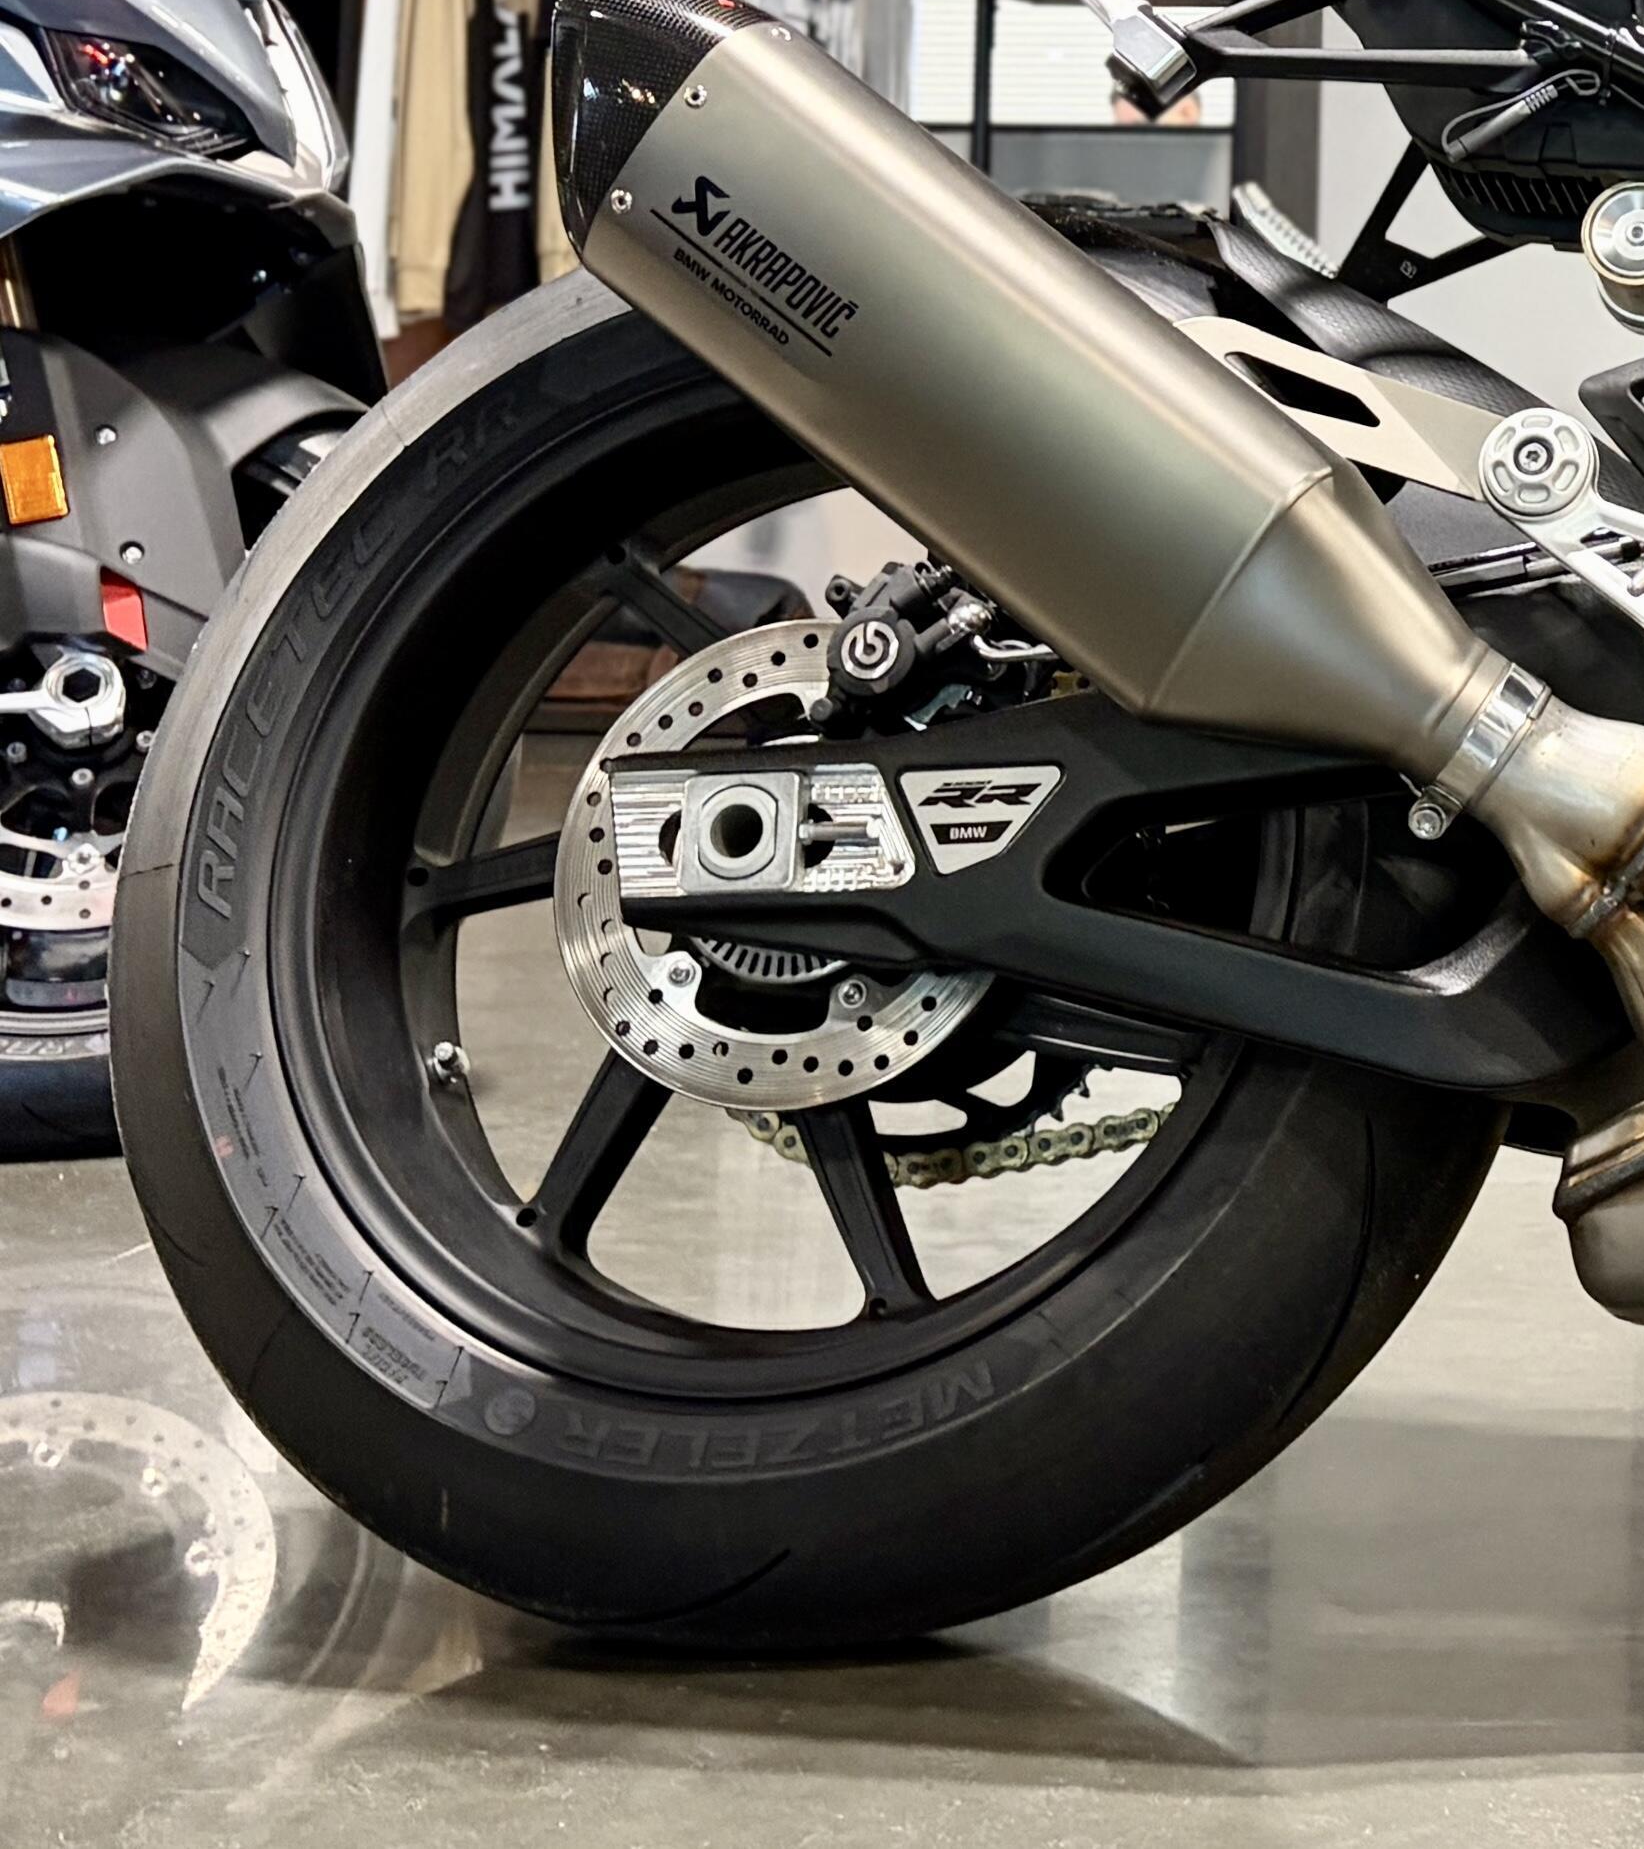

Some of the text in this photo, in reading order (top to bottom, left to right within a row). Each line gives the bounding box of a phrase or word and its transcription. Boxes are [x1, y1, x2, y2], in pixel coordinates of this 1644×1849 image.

[673, 246, 790, 345] BMW MOTORRAD
[948, 825, 989, 841] BMW
